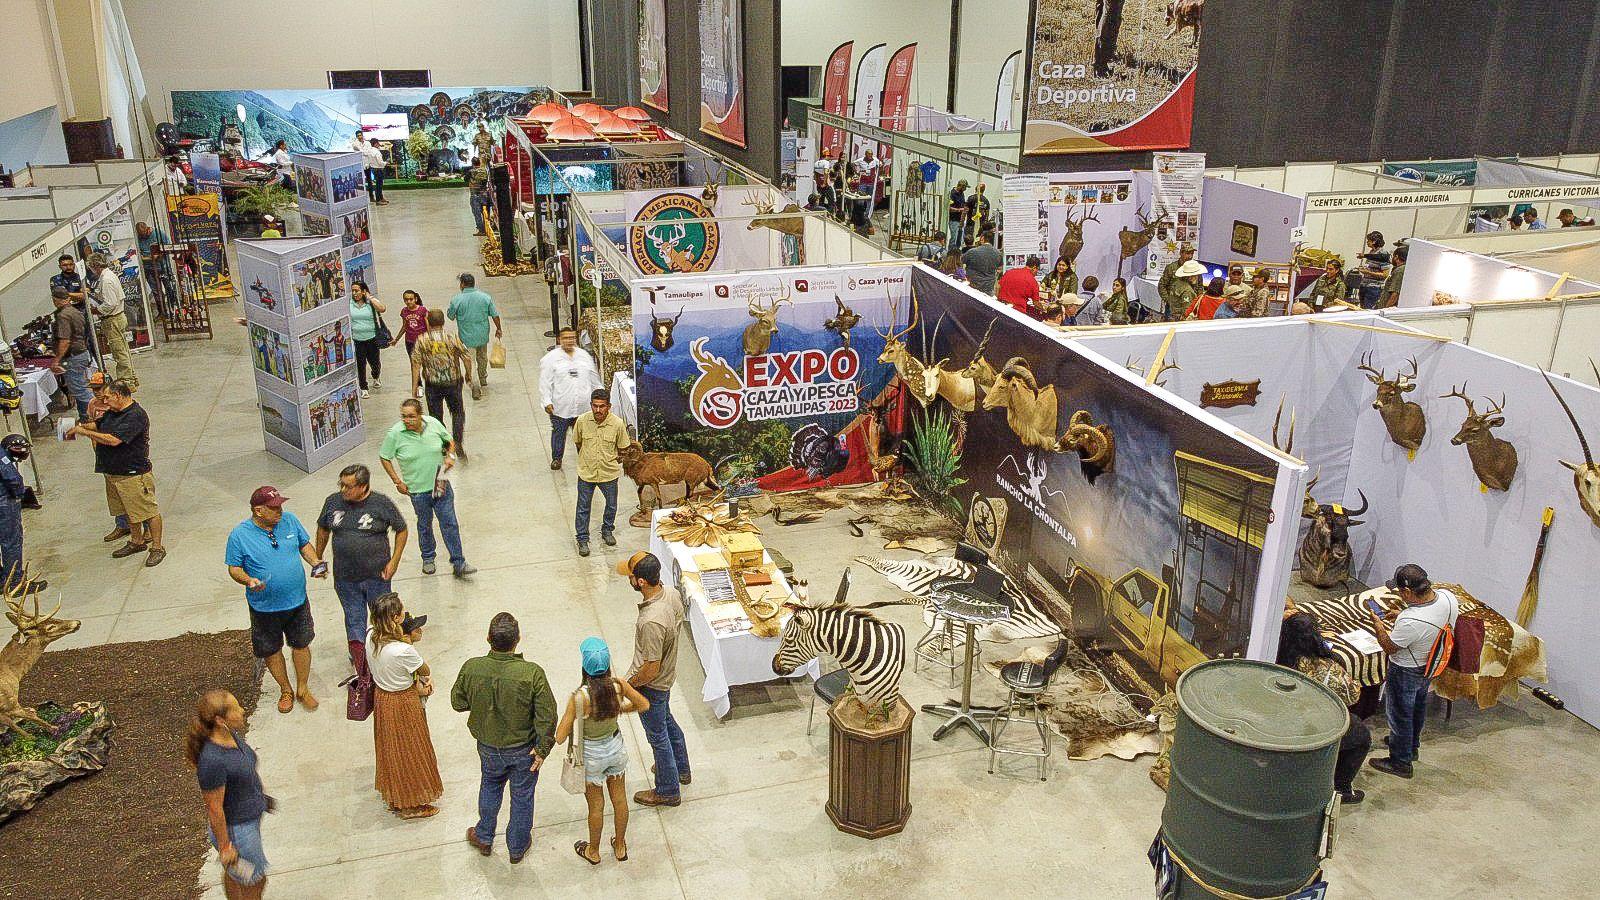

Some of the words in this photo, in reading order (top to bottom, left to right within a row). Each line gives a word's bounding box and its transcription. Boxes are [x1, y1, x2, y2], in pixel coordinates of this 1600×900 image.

[1039, 60, 1086, 80] Caza
[1037, 83, 1137, 109] Deportiva
[1310, 197, 1348, 207] "CENTER"
[1348, 196, 1393, 206] ACCESORIOS
[1394, 195, 1413, 204] PARA
[1508, 188, 1561, 200] CURRICANES
[1563, 186, 1600, 198] VICTORIA
[634, 213, 658, 275] FEDERACIN
[648, 199, 700, 216] MEXICANA
[706, 225, 715, 251] CAZA
[859, 278, 876, 286] Caza
[883, 276, 904, 284] Pesca
[664, 291, 704, 300] Tamaulipas
[746, 350, 858, 388] EXPO
[747, 387, 789, 406] CAZA
[795, 386, 808, 403] Y
[808, 382, 857, 401] PESCA
[747, 401, 826, 421] TAMAULIPAS
[829, 397, 857, 414] 2023
[996, 473, 1023, 502] RANCHO
[1024, 497, 1033, 511] LA
[1034, 506, 1077, 548] CHONTALPA
